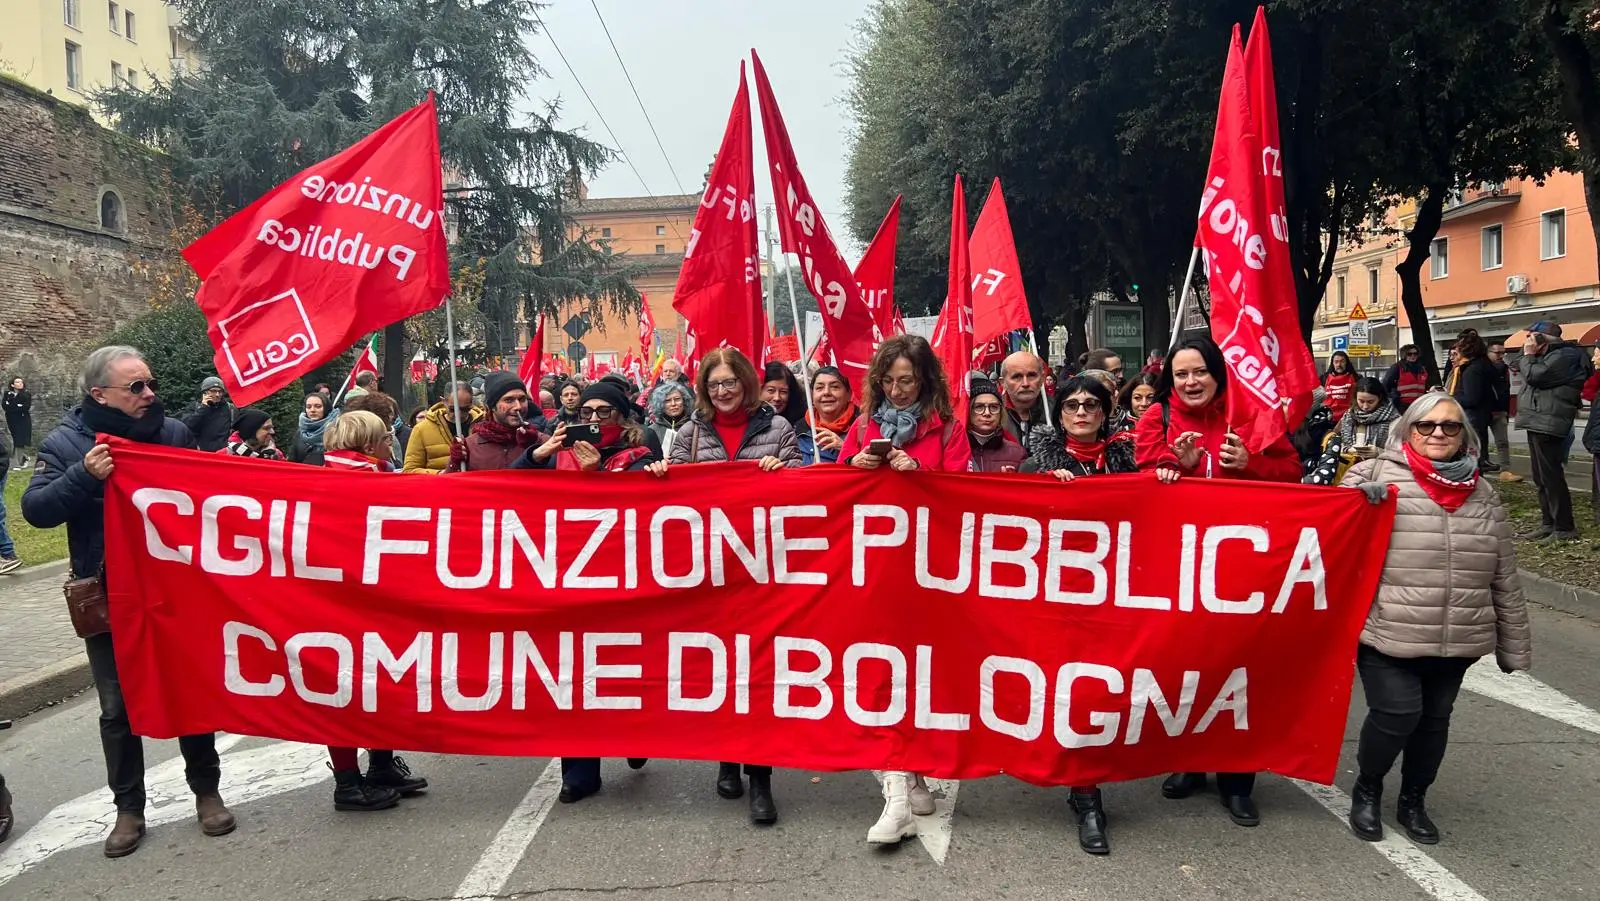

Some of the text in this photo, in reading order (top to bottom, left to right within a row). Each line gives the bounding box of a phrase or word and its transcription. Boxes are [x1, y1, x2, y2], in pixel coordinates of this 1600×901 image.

[1223, 345, 1279, 401] CGIL
[1335, 338, 1344, 349] P
[131, 488, 1328, 614] CGIL FUNZIONE PUBBLICA
[222, 620, 1250, 749] COMUNE DI BOLOGNA
